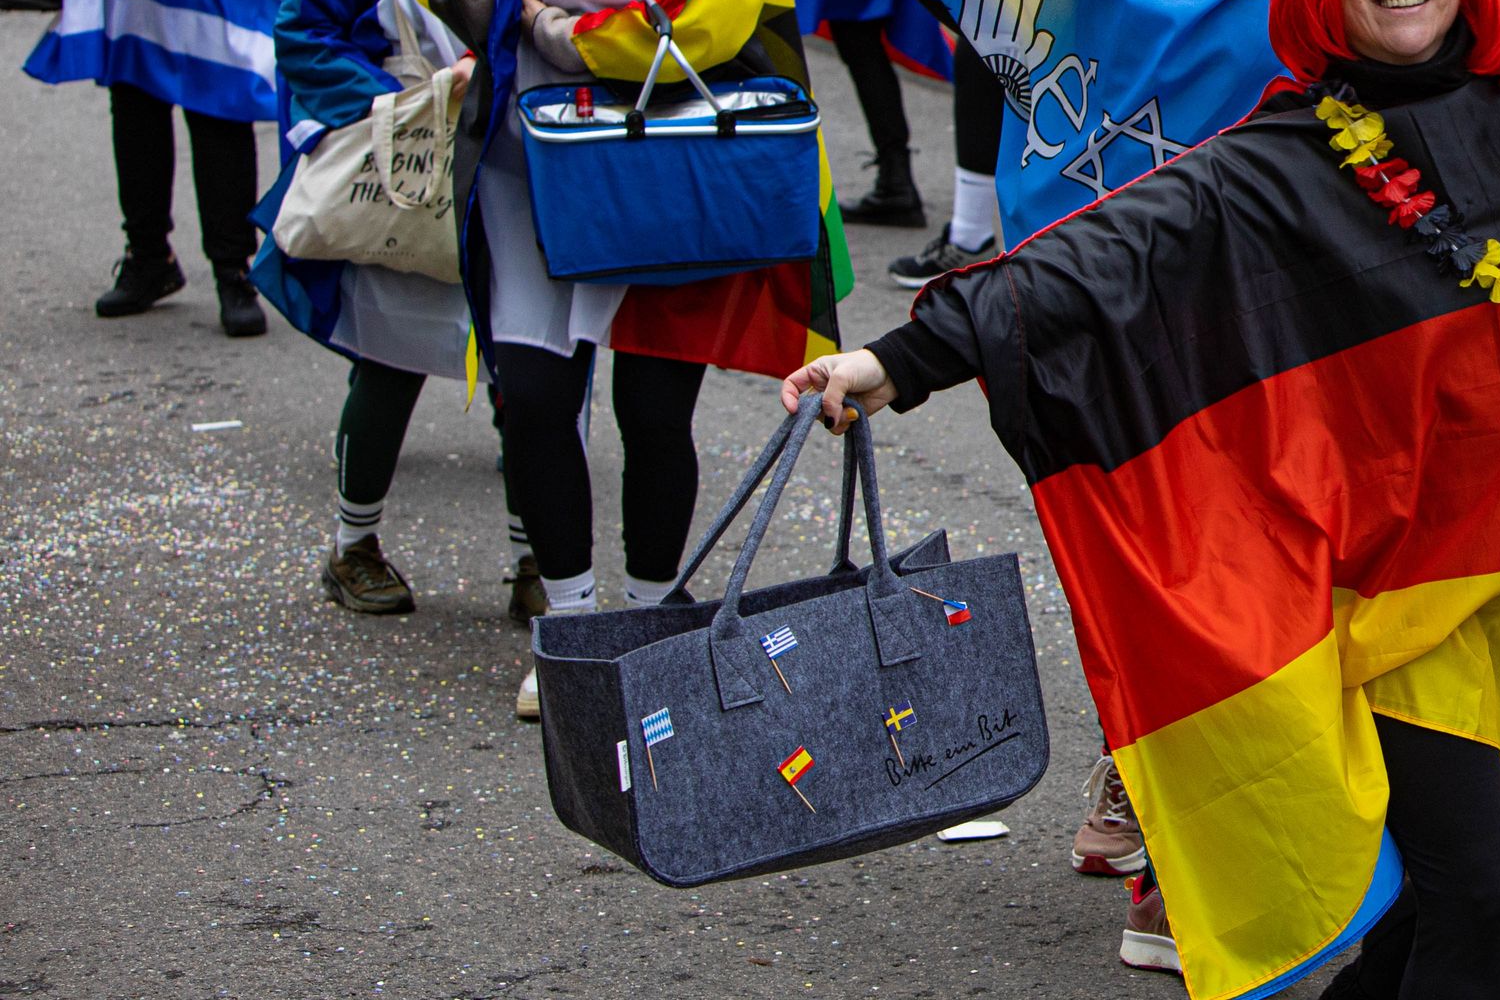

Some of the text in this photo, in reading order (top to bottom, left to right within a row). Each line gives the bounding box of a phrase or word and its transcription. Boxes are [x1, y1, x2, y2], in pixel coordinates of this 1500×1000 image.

[884, 708, 1018, 787] Bitte ein Bit
